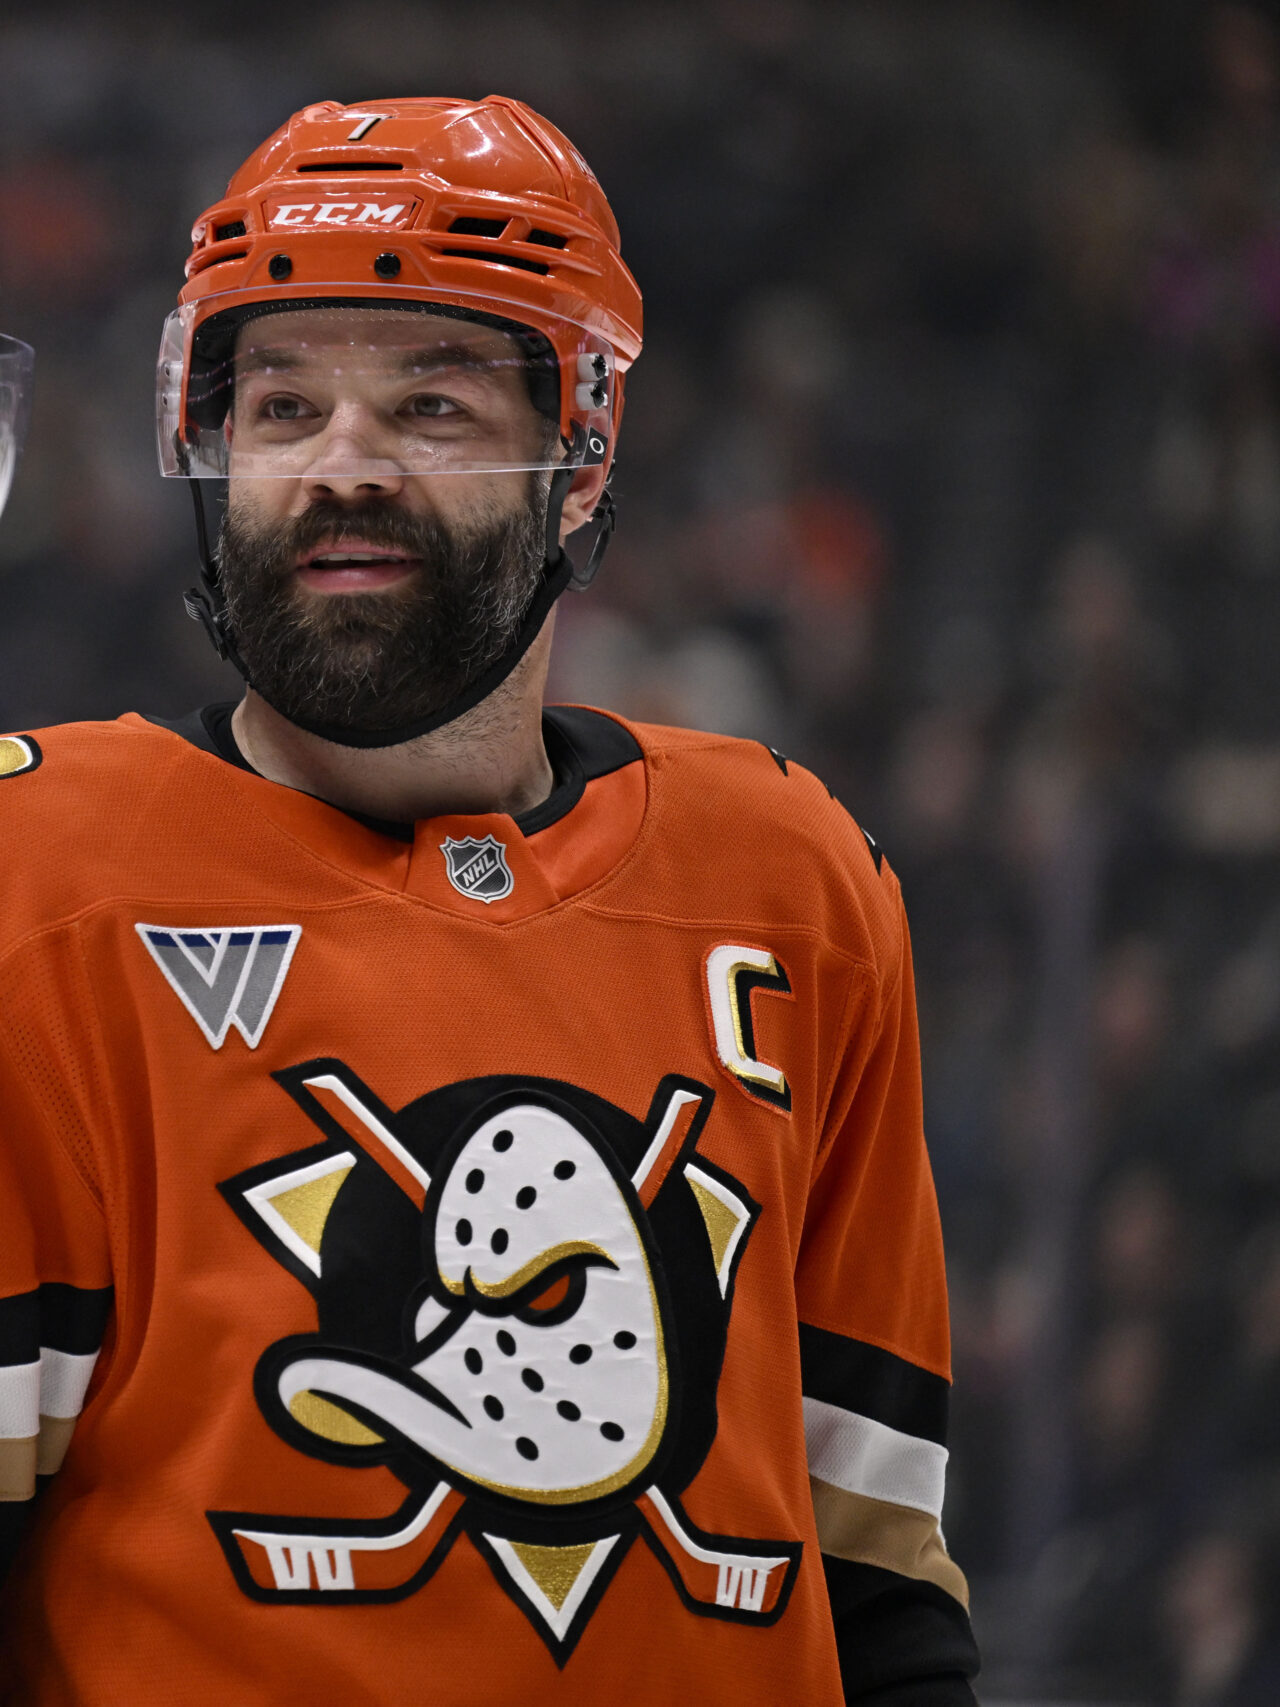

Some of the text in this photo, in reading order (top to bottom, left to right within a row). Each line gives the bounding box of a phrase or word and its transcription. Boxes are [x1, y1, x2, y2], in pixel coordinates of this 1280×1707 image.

[346, 114, 396, 141] 7
[270, 203, 405, 225] CCM
[462, 853, 495, 887] NHL
[705, 944, 792, 1113] C
